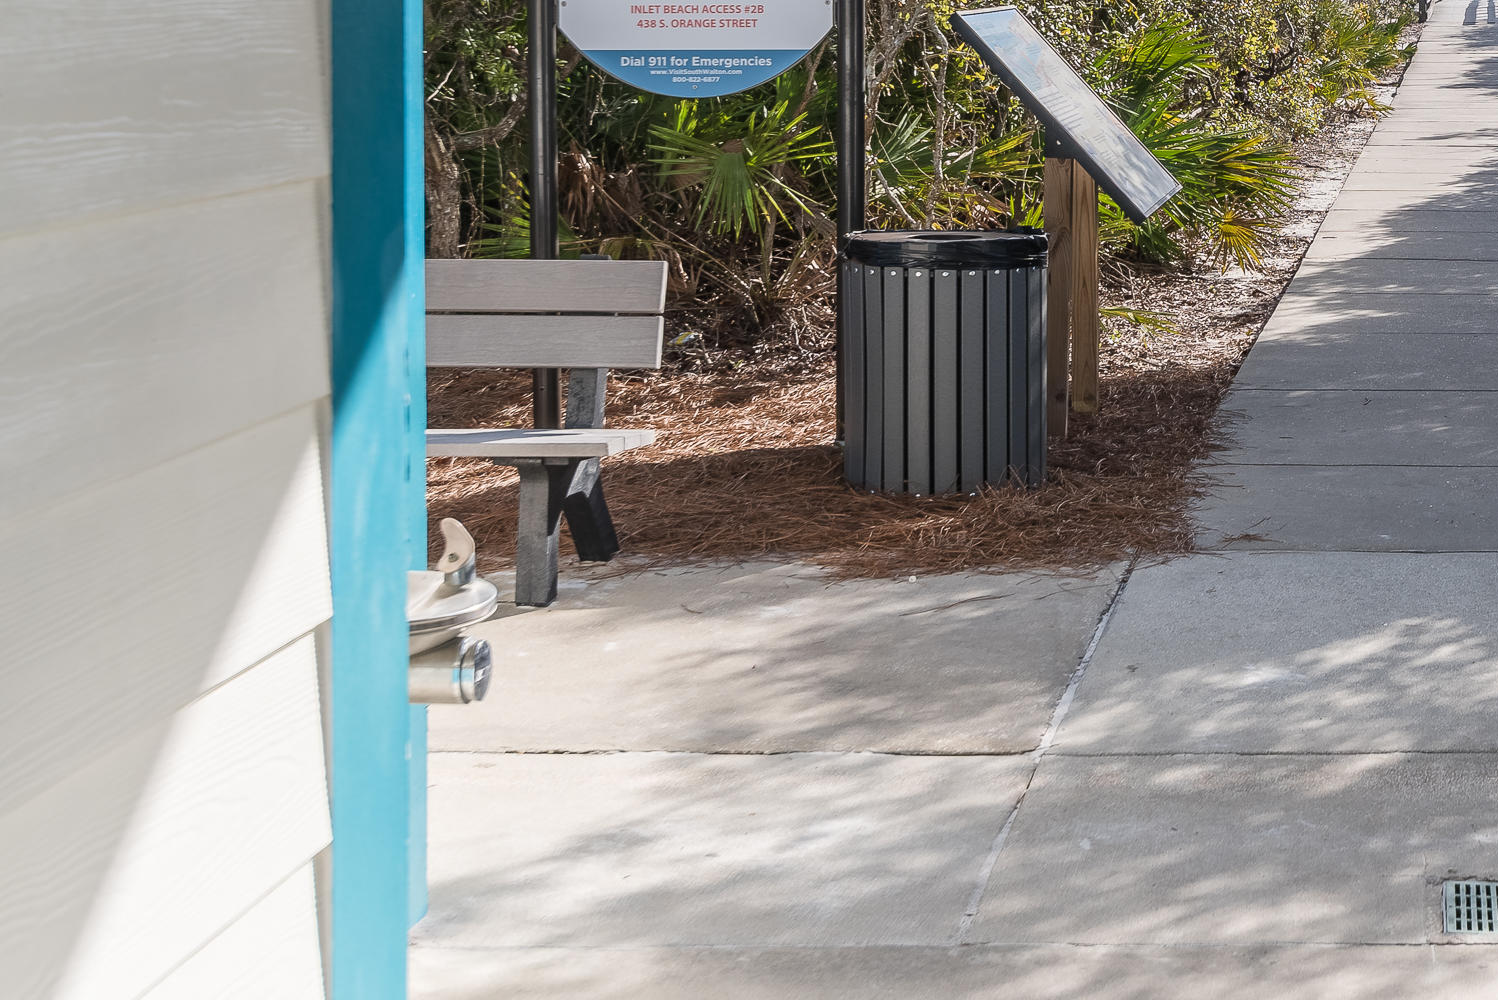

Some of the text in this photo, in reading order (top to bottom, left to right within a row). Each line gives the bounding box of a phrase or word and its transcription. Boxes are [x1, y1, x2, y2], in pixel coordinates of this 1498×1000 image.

[630, 4, 764, 14] INLET BEACH ACCESS #2B
[636, 19, 758, 28] 438 S. ORANGE STREET
[620, 56, 772, 68] Dial 911 for Emergencies
